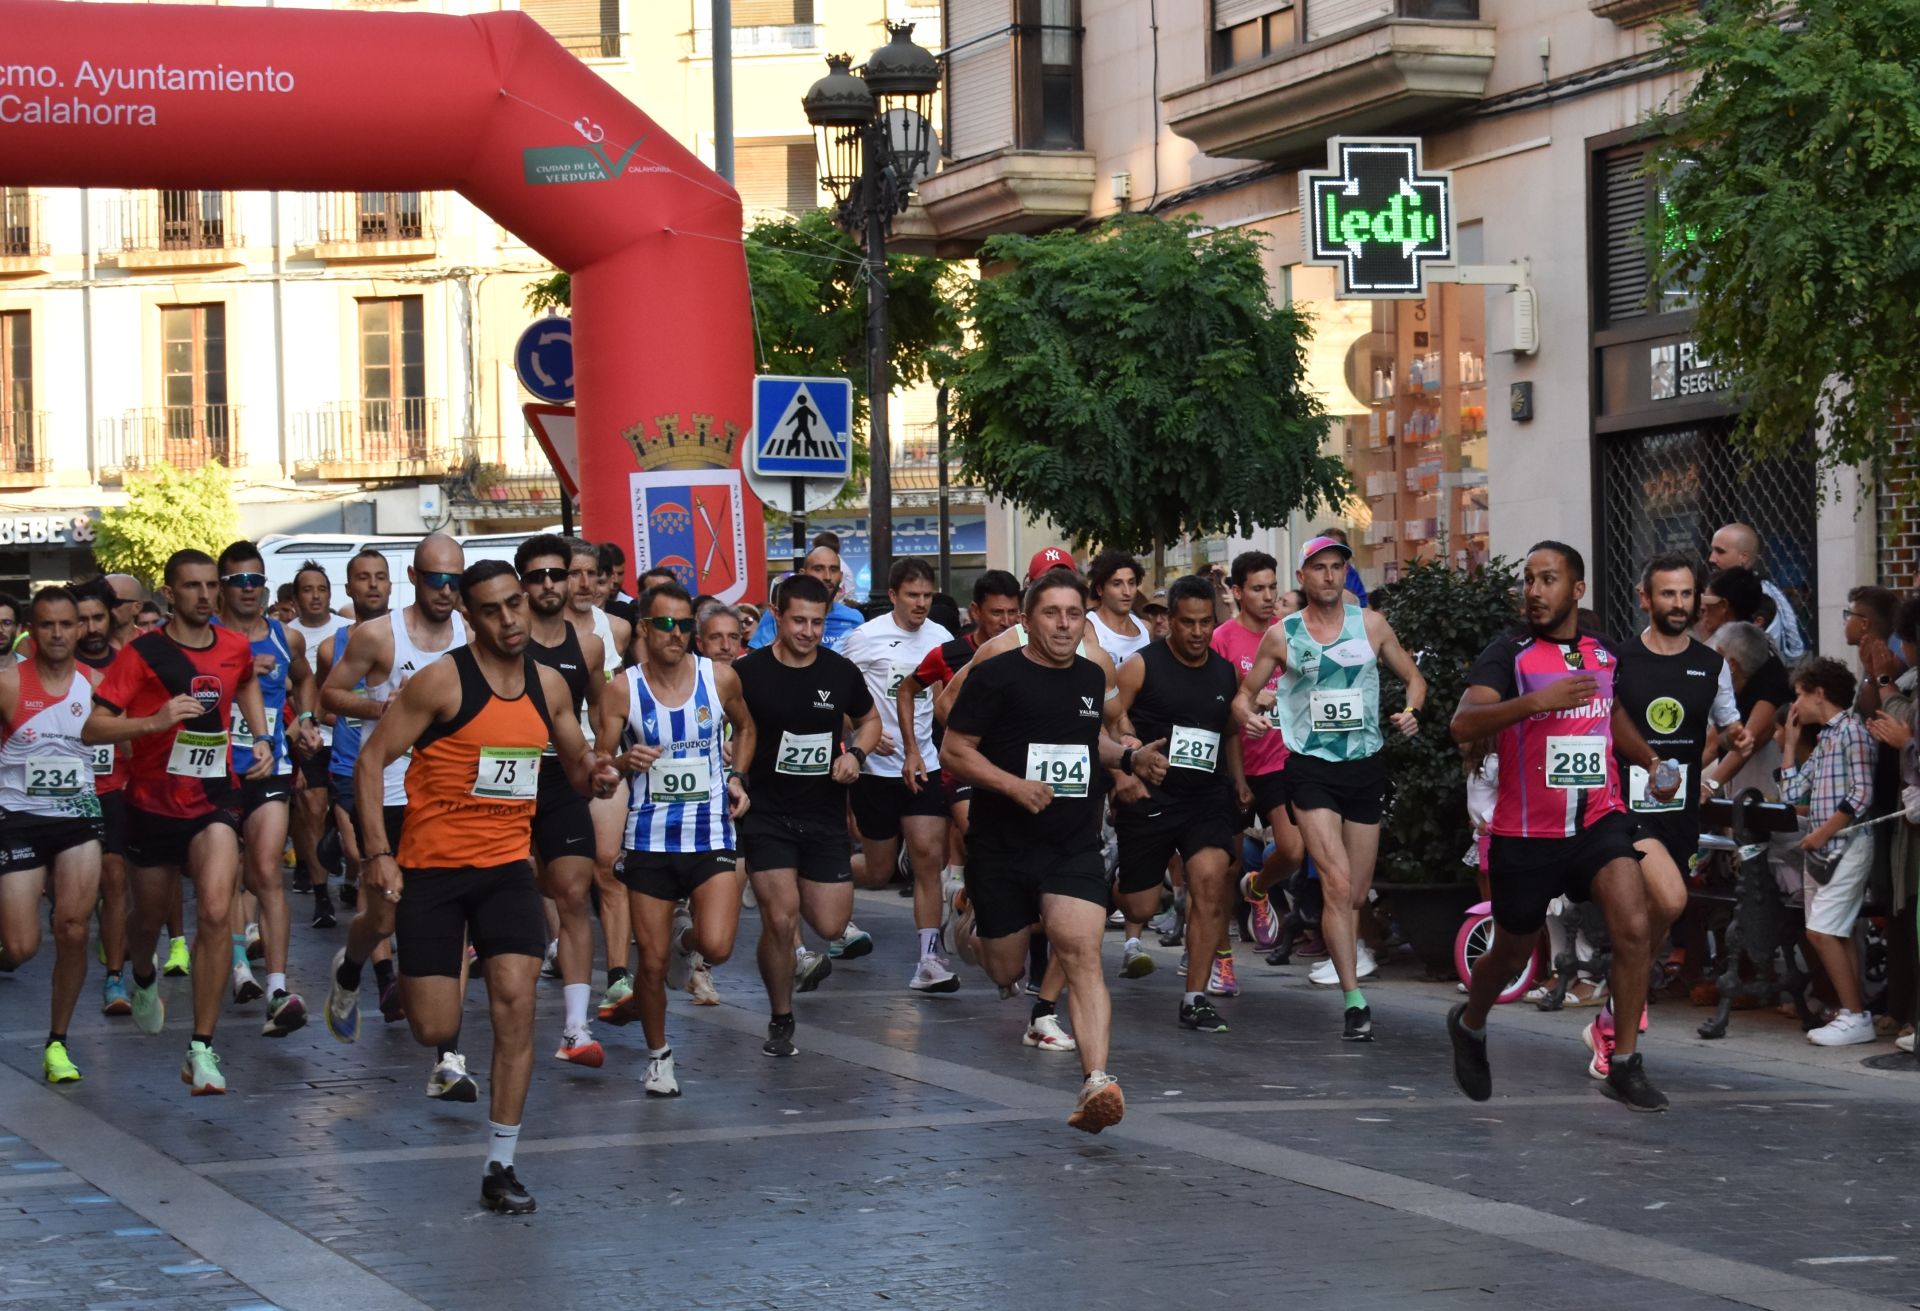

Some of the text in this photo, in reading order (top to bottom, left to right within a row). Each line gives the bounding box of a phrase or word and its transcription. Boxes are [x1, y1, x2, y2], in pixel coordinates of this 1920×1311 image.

[74, 60, 295, 96] Ayuntamiento
[0, 95, 157, 126] Calahorra
[536, 162, 600, 173] CIUDAD DE LA
[546, 171, 606, 184] VERDURA
[634, 488, 642, 510] SAN
[0, 516, 66, 545] BEBE
[736, 513, 744, 581] EMETERIO
[1323, 702, 1352, 720] 95
[189, 748, 216, 766] 176
[784, 746, 827, 764] 276
[1175, 739, 1215, 760] 287
[494, 760, 517, 784] 73
[1036, 760, 1084, 782] 194
[1553, 752, 1601, 774] 288
[32, 769, 78, 788] 234
[663, 773, 697, 793] 90
